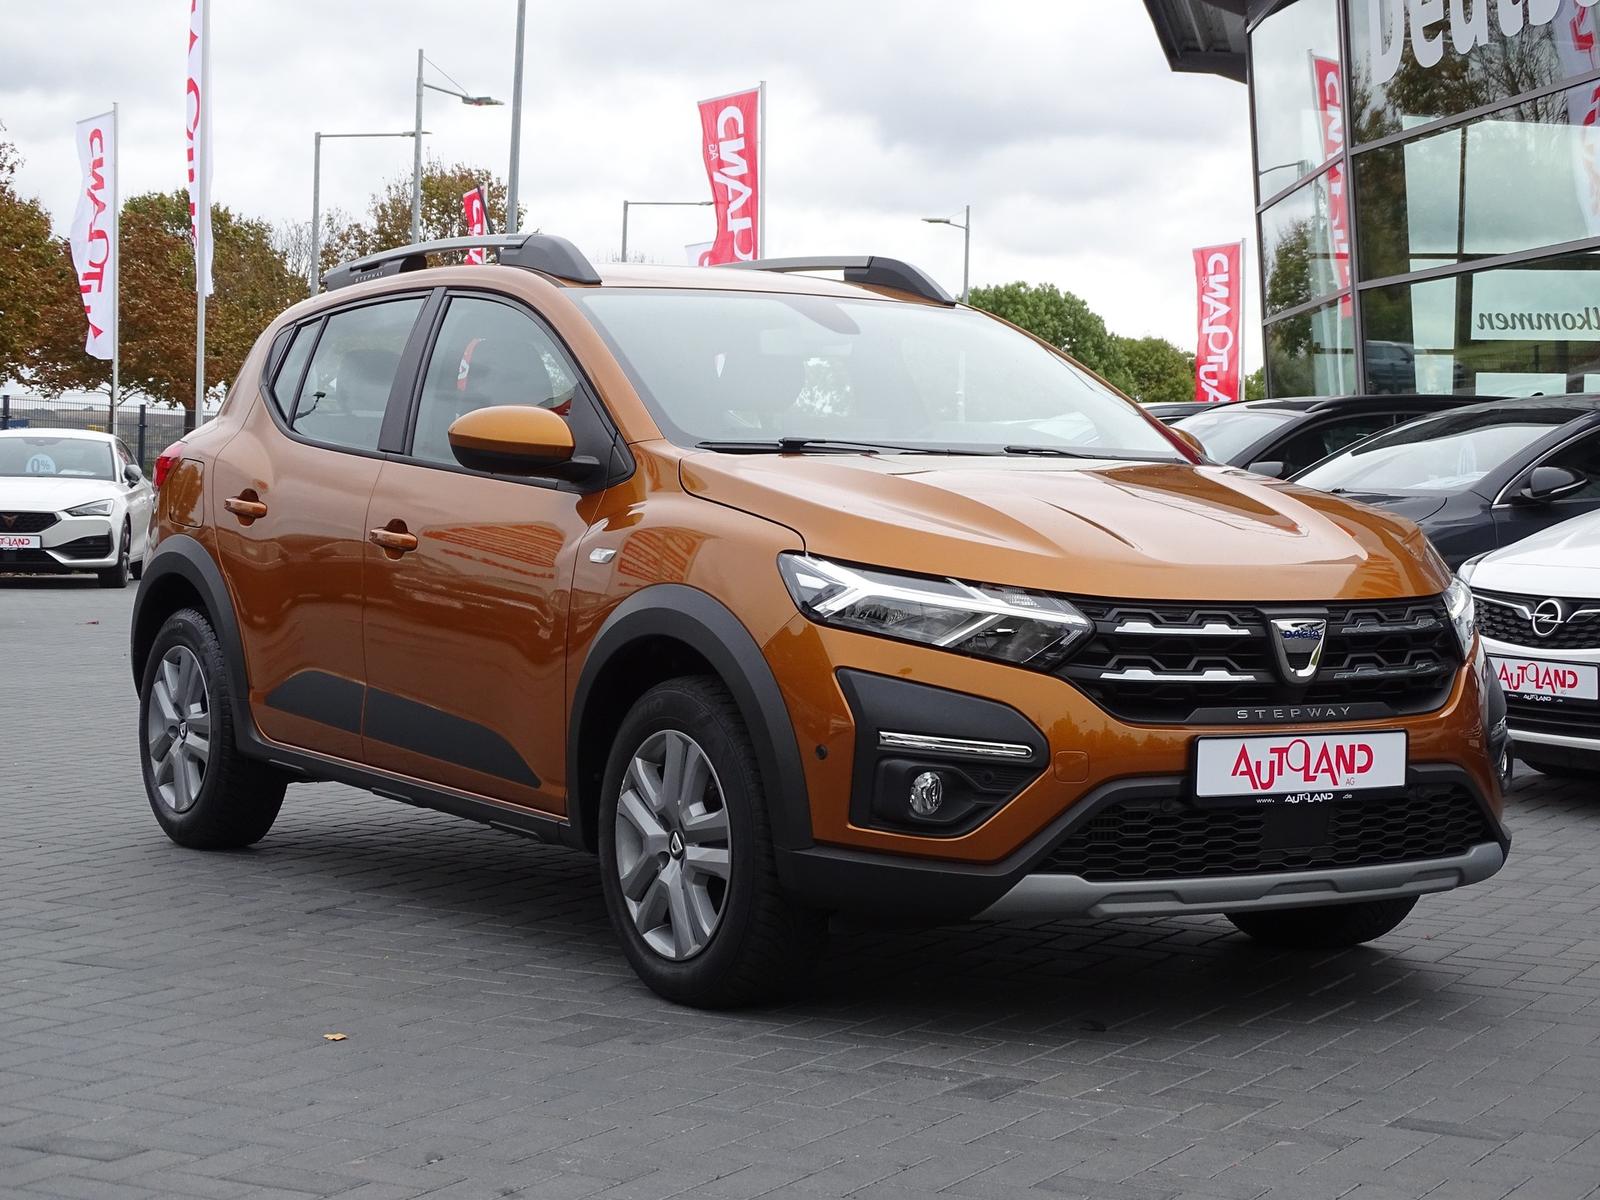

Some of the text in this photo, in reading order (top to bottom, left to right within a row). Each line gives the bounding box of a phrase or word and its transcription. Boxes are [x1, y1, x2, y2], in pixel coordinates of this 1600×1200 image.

[1498, 661, 1578, 694] AUTOLAND
[1236, 706, 1350, 719] STEPWAY
[1231, 738, 1374, 790] AUTOLAND
[1345, 777, 1356, 786] AG
[1284, 792, 1334, 804] AUTOLAND
